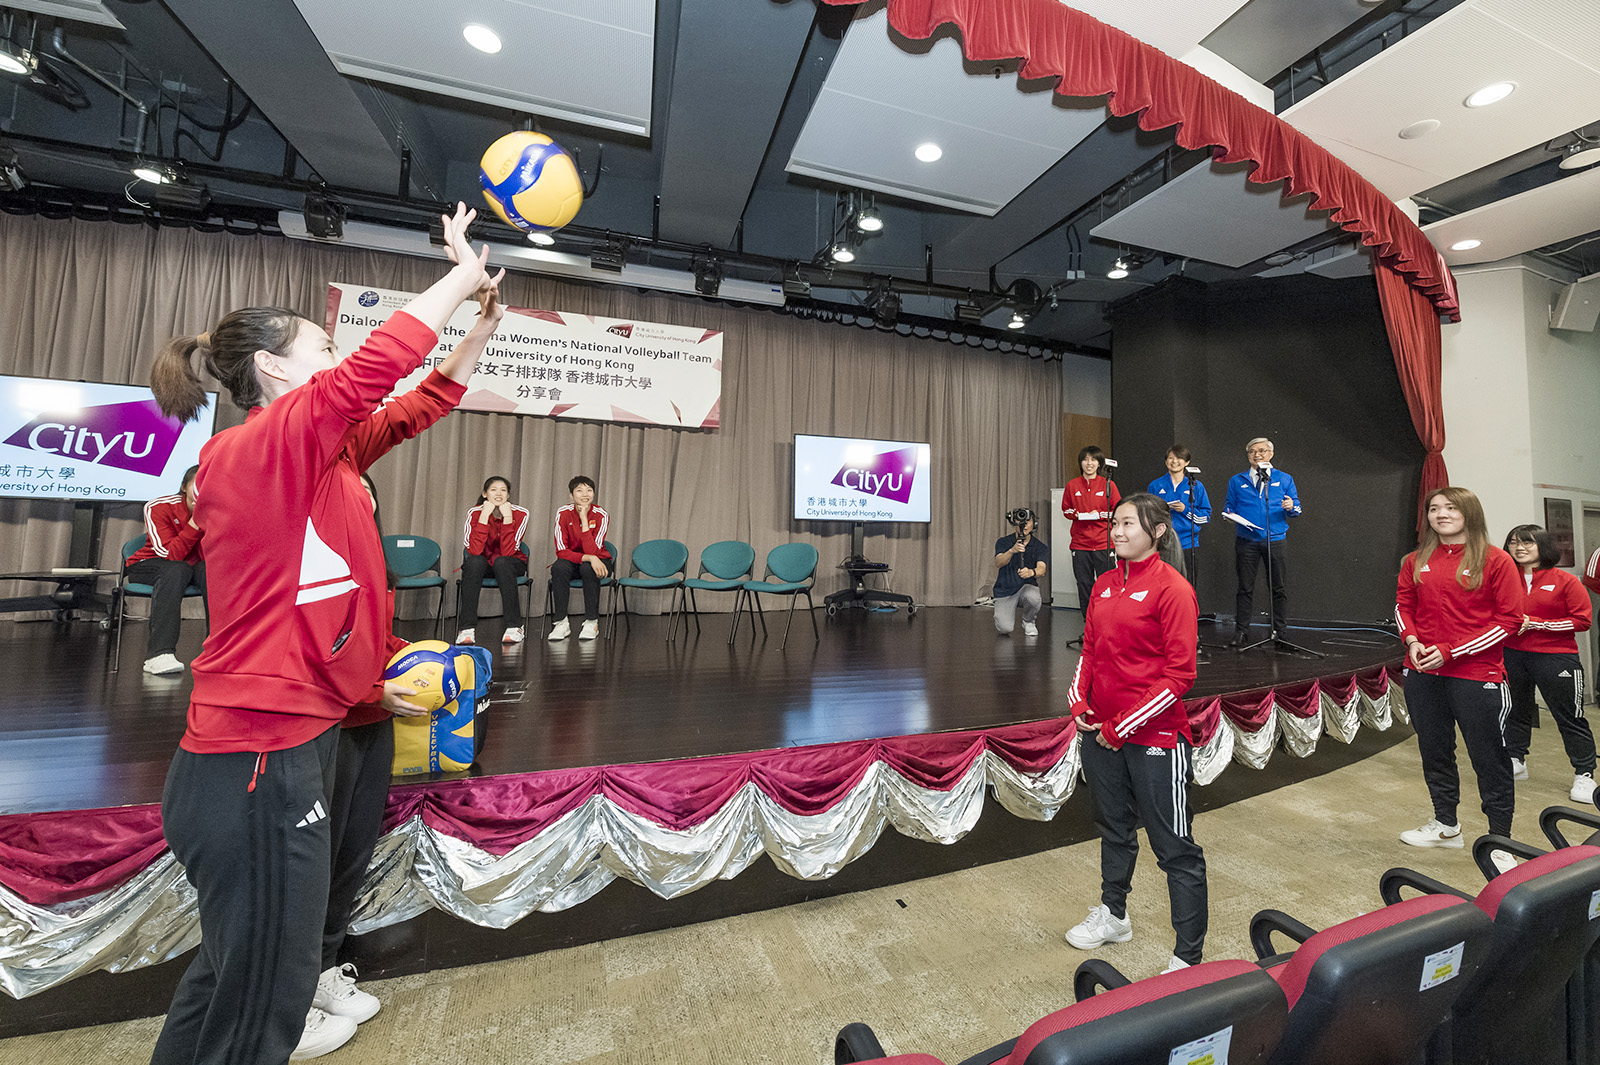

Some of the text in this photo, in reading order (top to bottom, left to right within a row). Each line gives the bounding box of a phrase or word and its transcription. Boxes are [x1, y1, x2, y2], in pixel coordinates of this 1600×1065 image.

[443, 326, 466, 337] the
[510, 333, 567, 348] Women's
[570, 340, 622, 354] National
[624, 345, 680, 360] Volleyball
[682, 351, 712, 363] Team
[439, 343, 635, 372] at University of Hong Kong
[565, 370, 652, 390] 香港城市大學
[516, 384, 562, 401] 分享會
[28, 422, 156, 464] CityU
[40, 482, 55, 492] of
[57, 483, 92, 496] Hong
[94, 485, 126, 497] Kong
[842, 468, 903, 496] CityU
[807, 496, 867, 507] 香港城市大學
[806, 508, 820, 516] City
[820, 509, 851, 517] University
[859, 510, 876, 518] Hong
